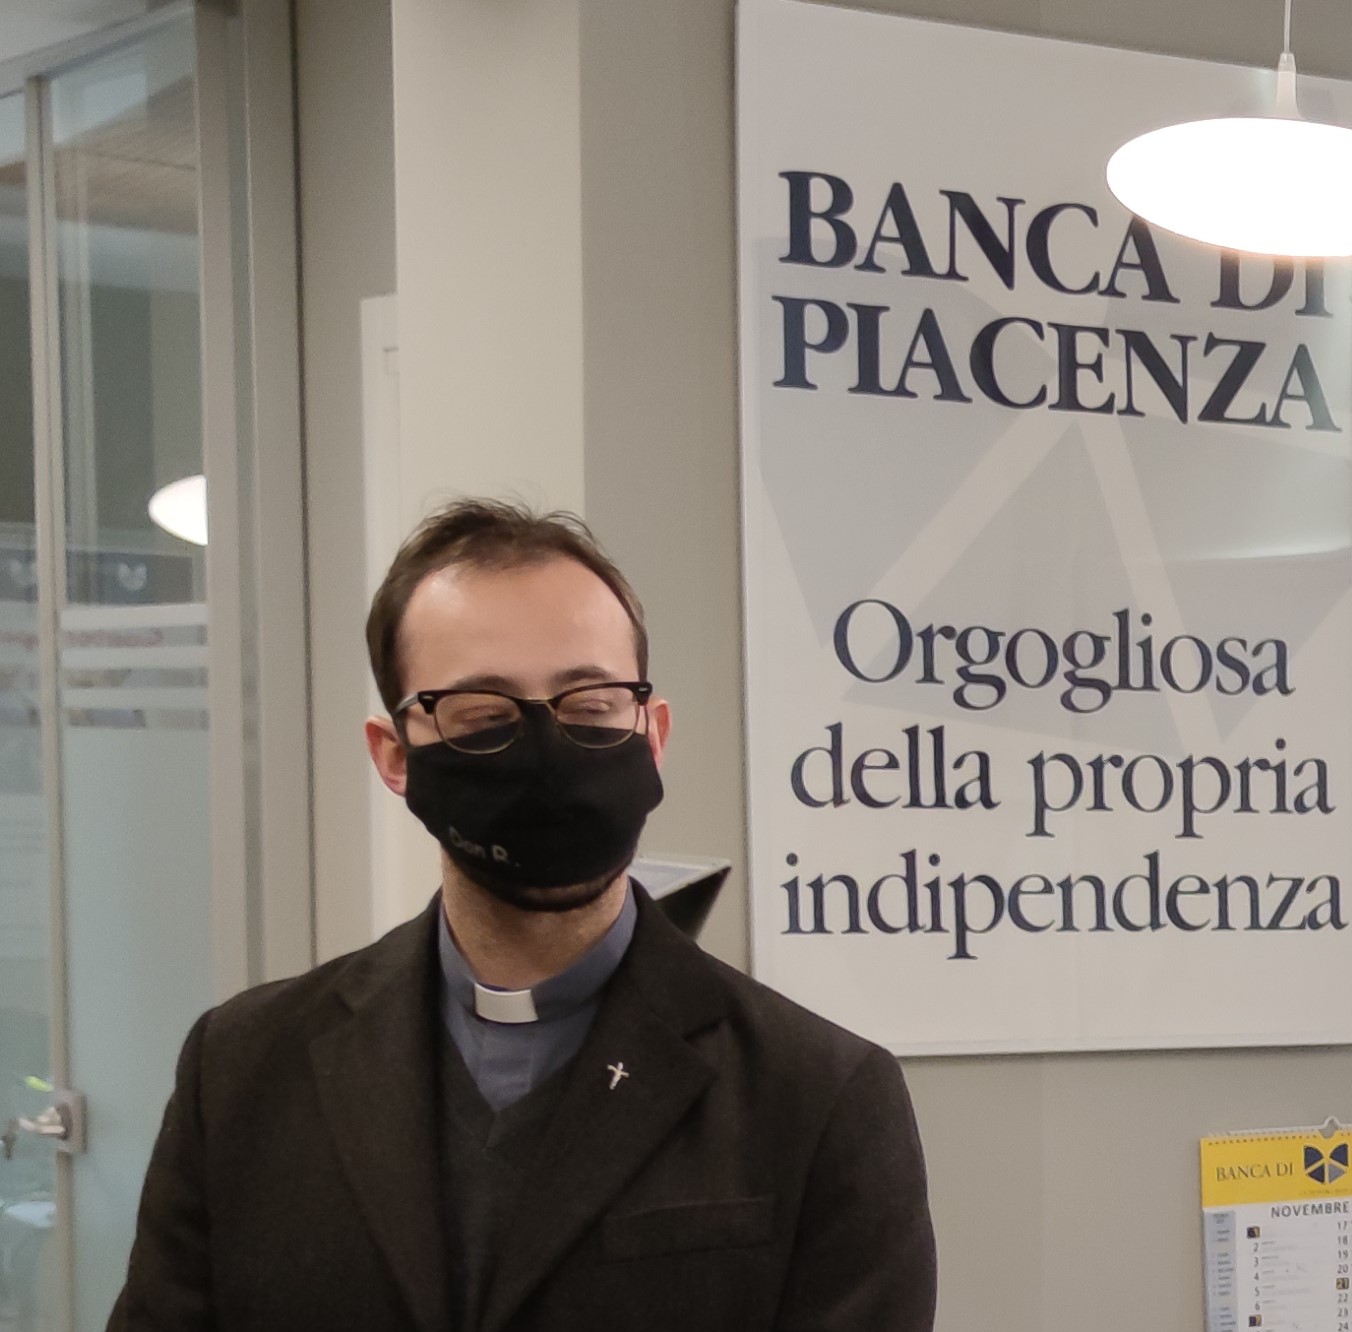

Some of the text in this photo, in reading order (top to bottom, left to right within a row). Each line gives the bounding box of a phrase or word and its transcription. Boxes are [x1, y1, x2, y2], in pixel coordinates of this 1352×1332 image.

[778, 171, 1181, 303] BANCA
[772, 295, 1342, 432] PIACENZA
[833, 599, 1297, 714] Orgogliosa
[790, 721, 1337, 839] della propria
[780, 849, 1349, 960] indipendenza
[1216, 1165, 1272, 1181] BANCA
[1276, 1162, 1293, 1177] DI
[1271, 1201, 1350, 1218] NOVEMBRE
